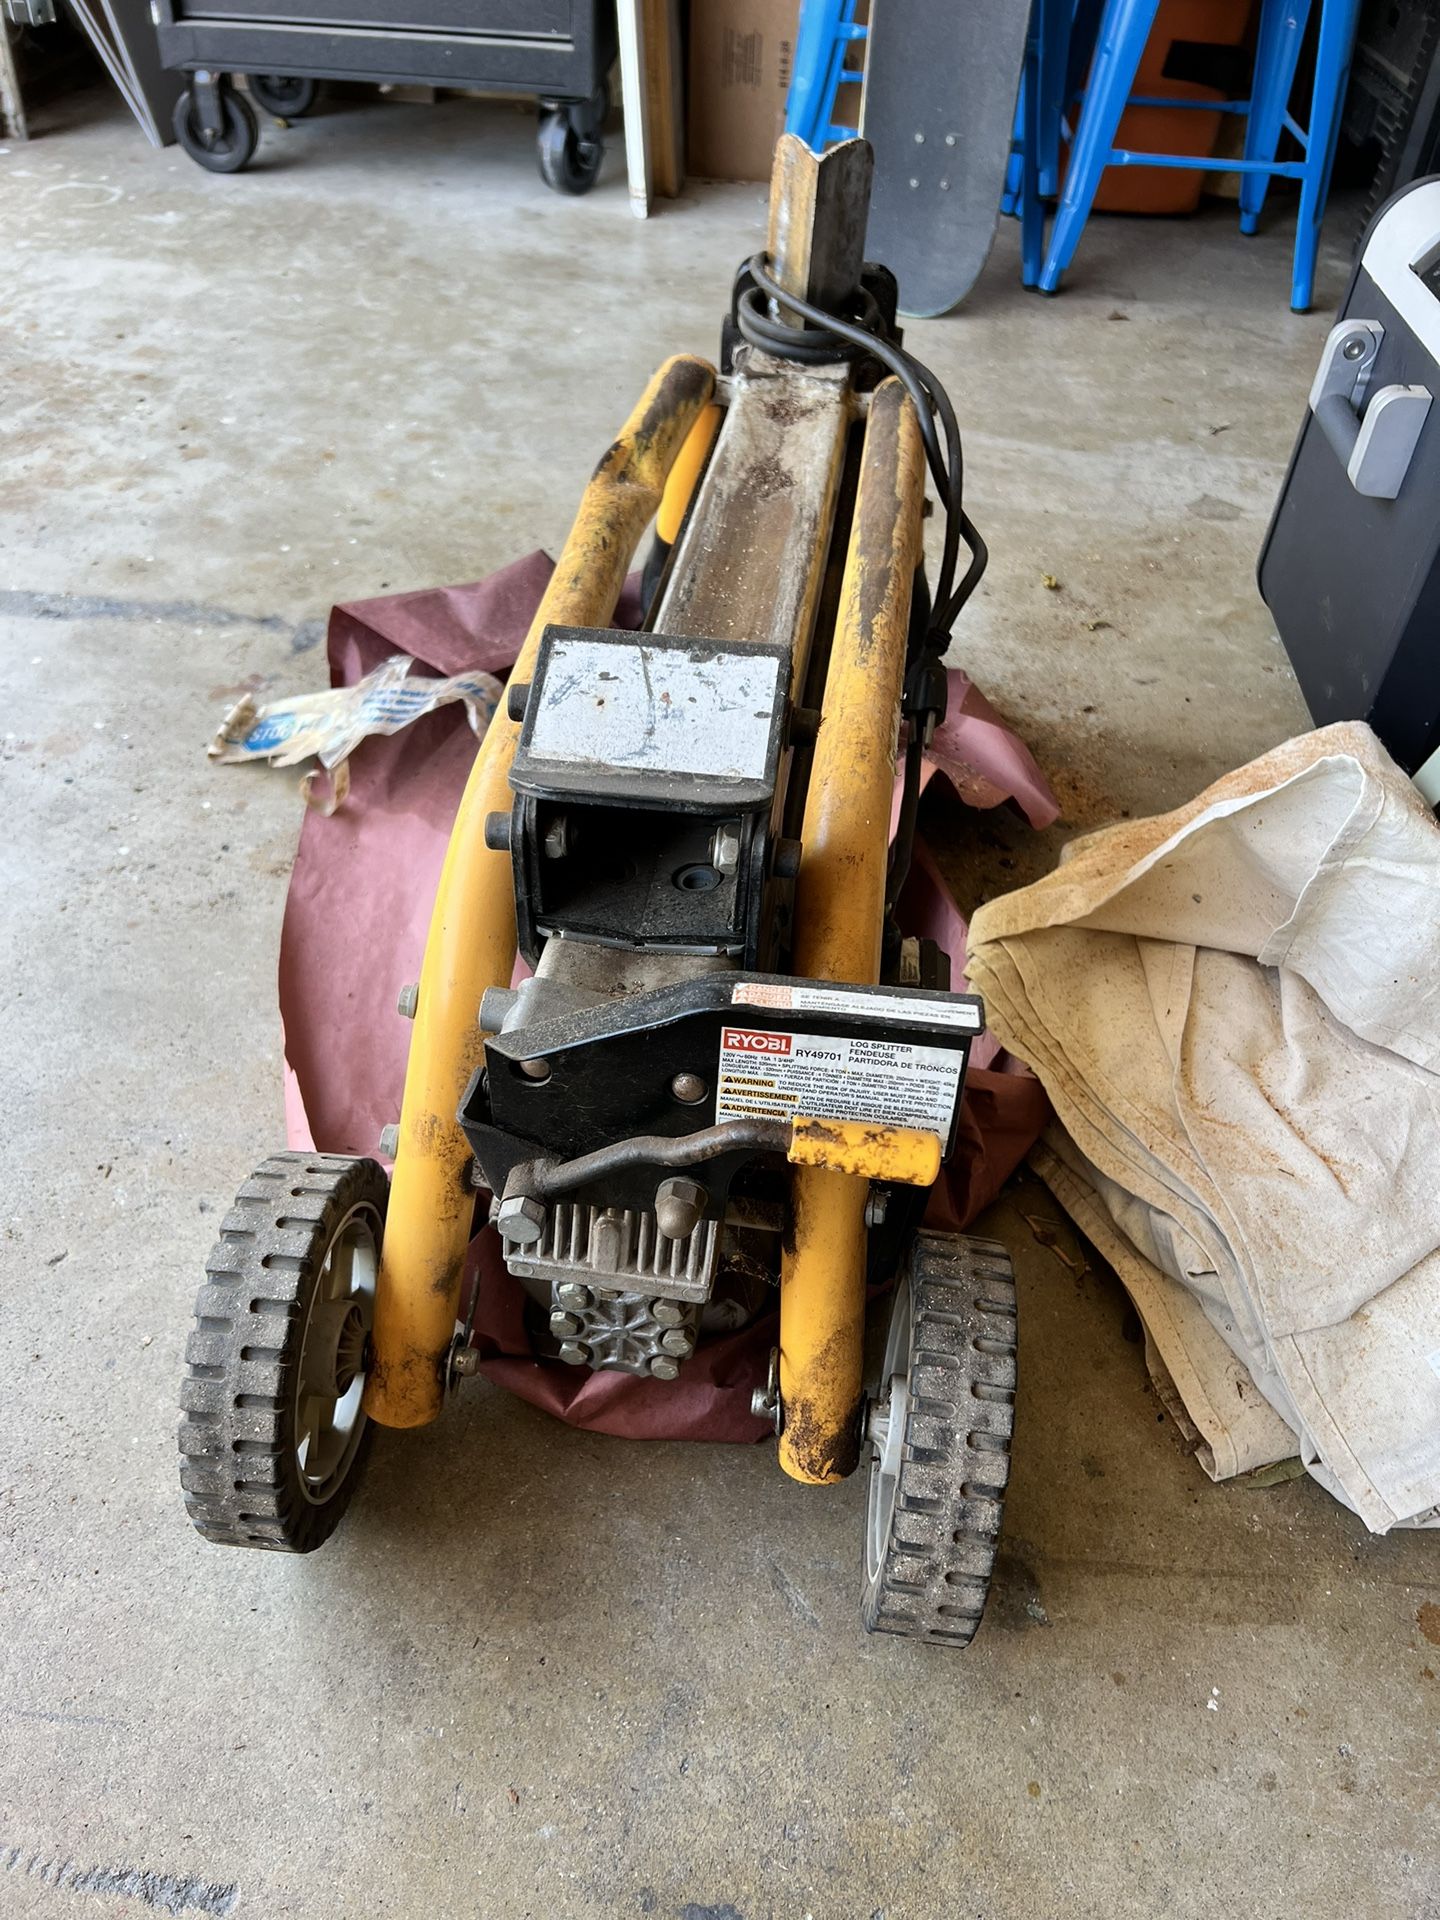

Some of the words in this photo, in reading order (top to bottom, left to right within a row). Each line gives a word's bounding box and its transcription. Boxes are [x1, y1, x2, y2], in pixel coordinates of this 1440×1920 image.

[850, 1048, 896, 1059] FENDEUSE
[871, 1043, 912, 1053] SPLITTER
[796, 1049, 842, 1061] RY49701
[782, 1063, 809, 1071] SPLITTING
[848, 1056, 898, 1067] PARTIDORA
[915, 1064, 958, 1074] TRONCOS
[733, 1077, 774, 1087] WARNING
[732, 1088, 798, 1102] AVERTISSEMENT
[778, 1086, 817, 1094] UNDERSTAND
[818, 1090, 854, 1098] OPERATOR'S
[731, 1106, 786, 1117] ADVERTENCIA
[835, 1110, 872, 1118] PROTECTION
[897, 1112, 938, 1121] COMPRENDRE
